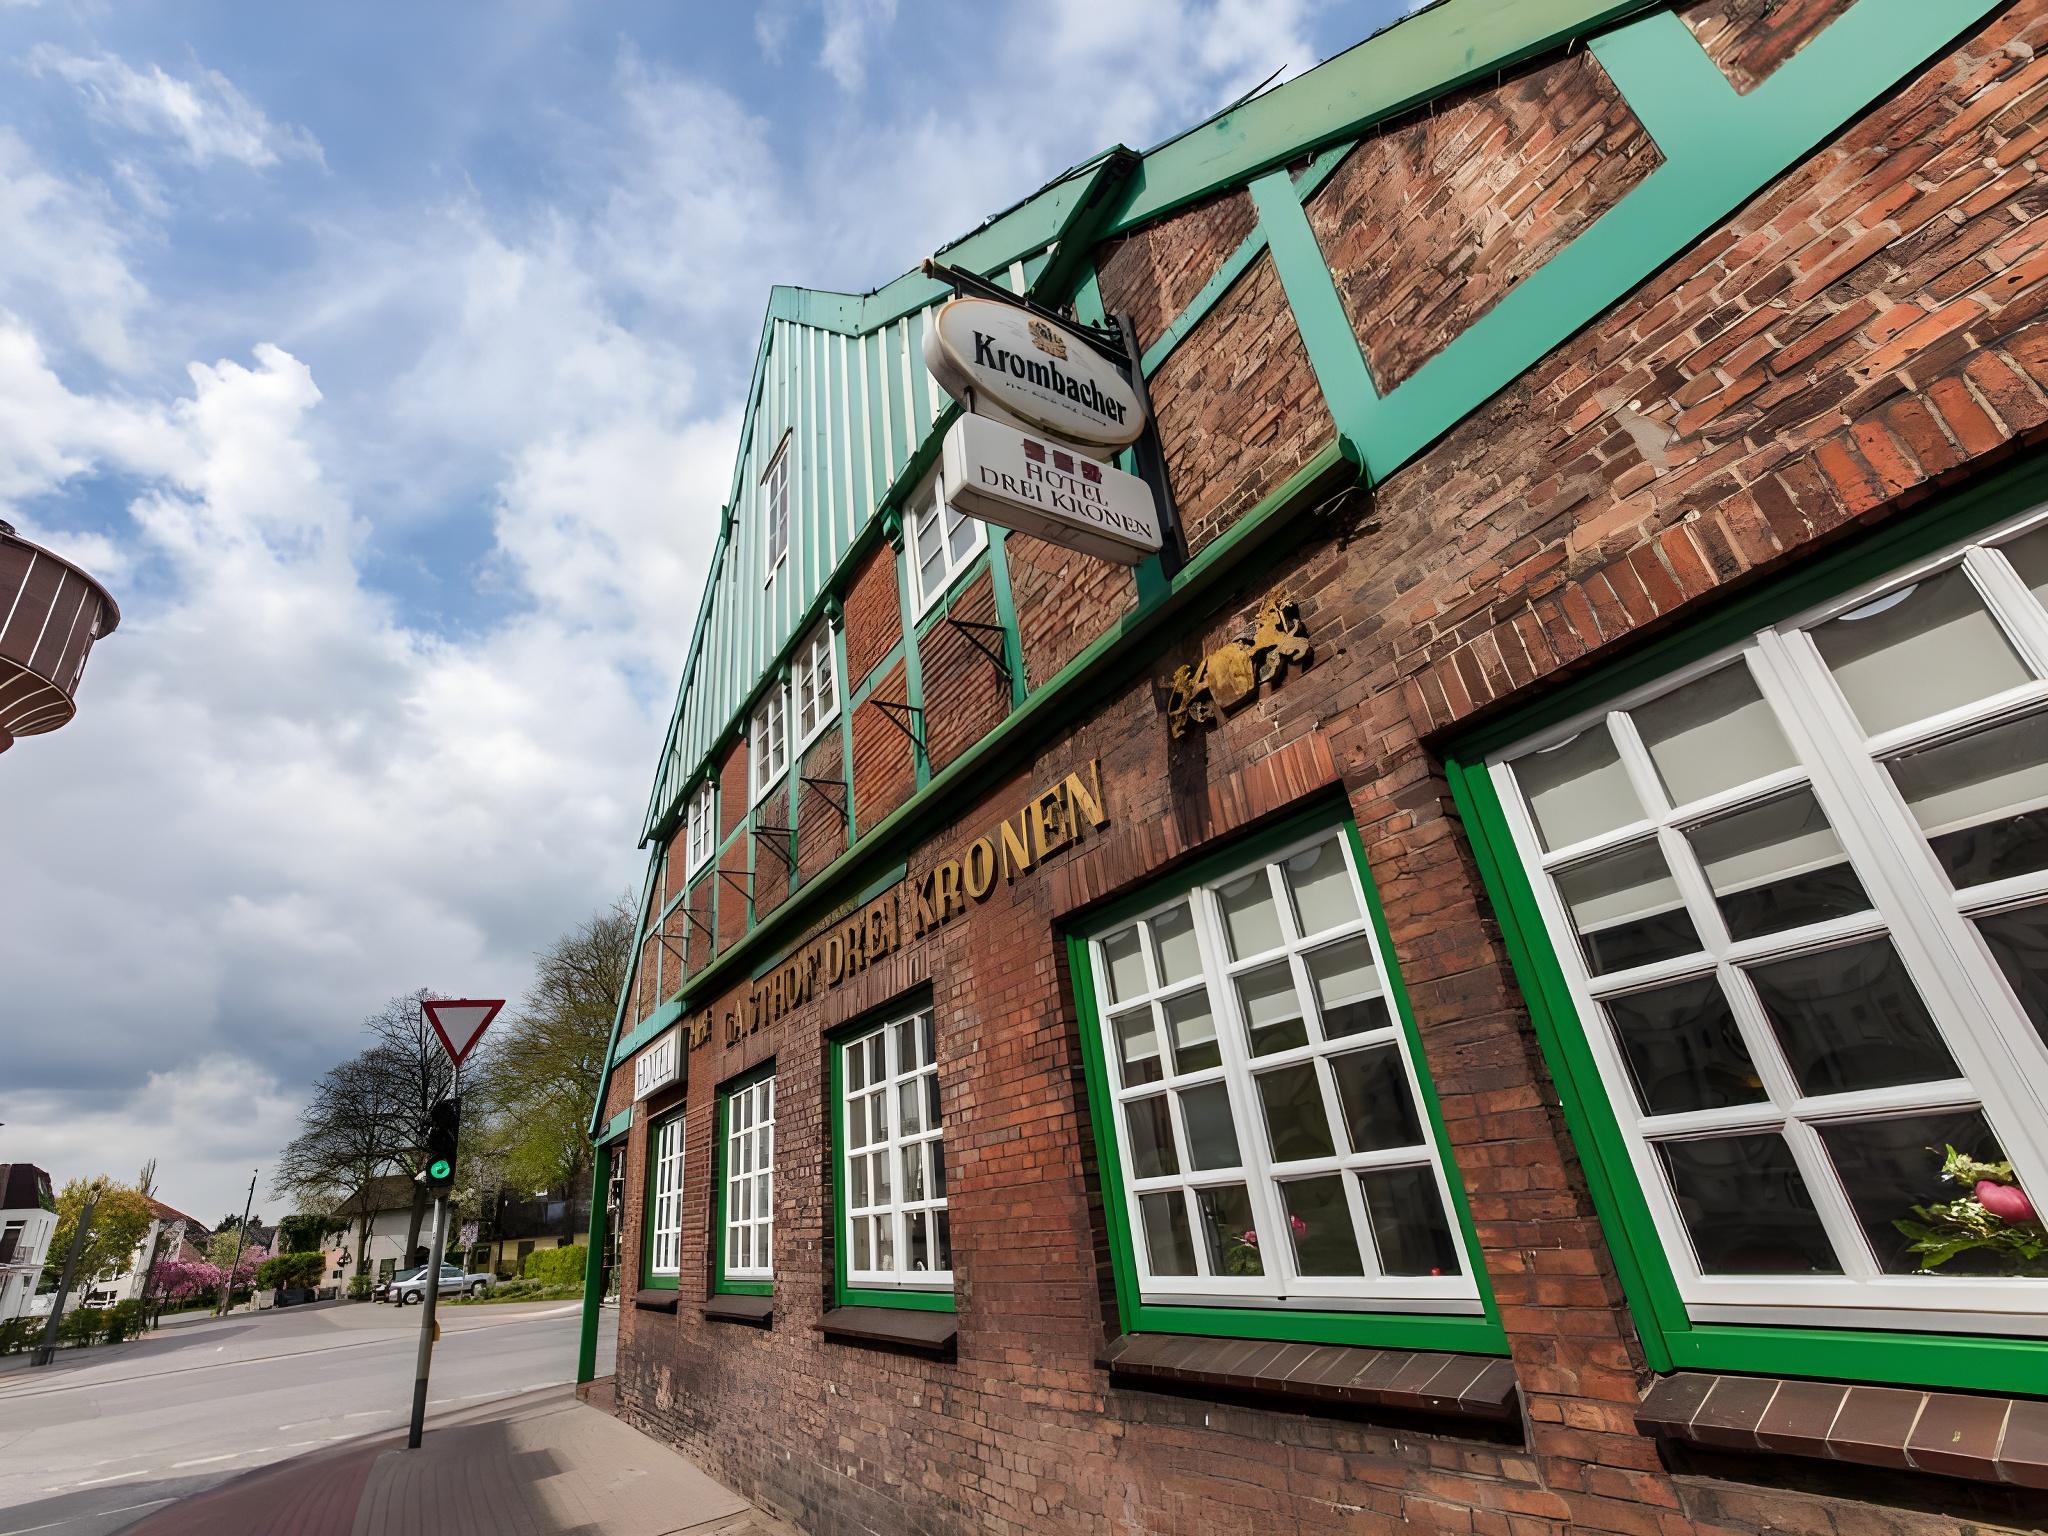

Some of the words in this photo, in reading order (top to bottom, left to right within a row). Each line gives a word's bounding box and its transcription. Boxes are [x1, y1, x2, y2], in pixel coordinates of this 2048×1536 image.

[972, 330, 1127, 426] Krombacher
[979, 465, 1043, 502] DREI
[1050, 490, 1153, 539] KRONEN
[1025, 462, 1109, 507] HOTEL
[825, 890, 900, 990] DREI
[911, 758, 1109, 940] KRONEN
